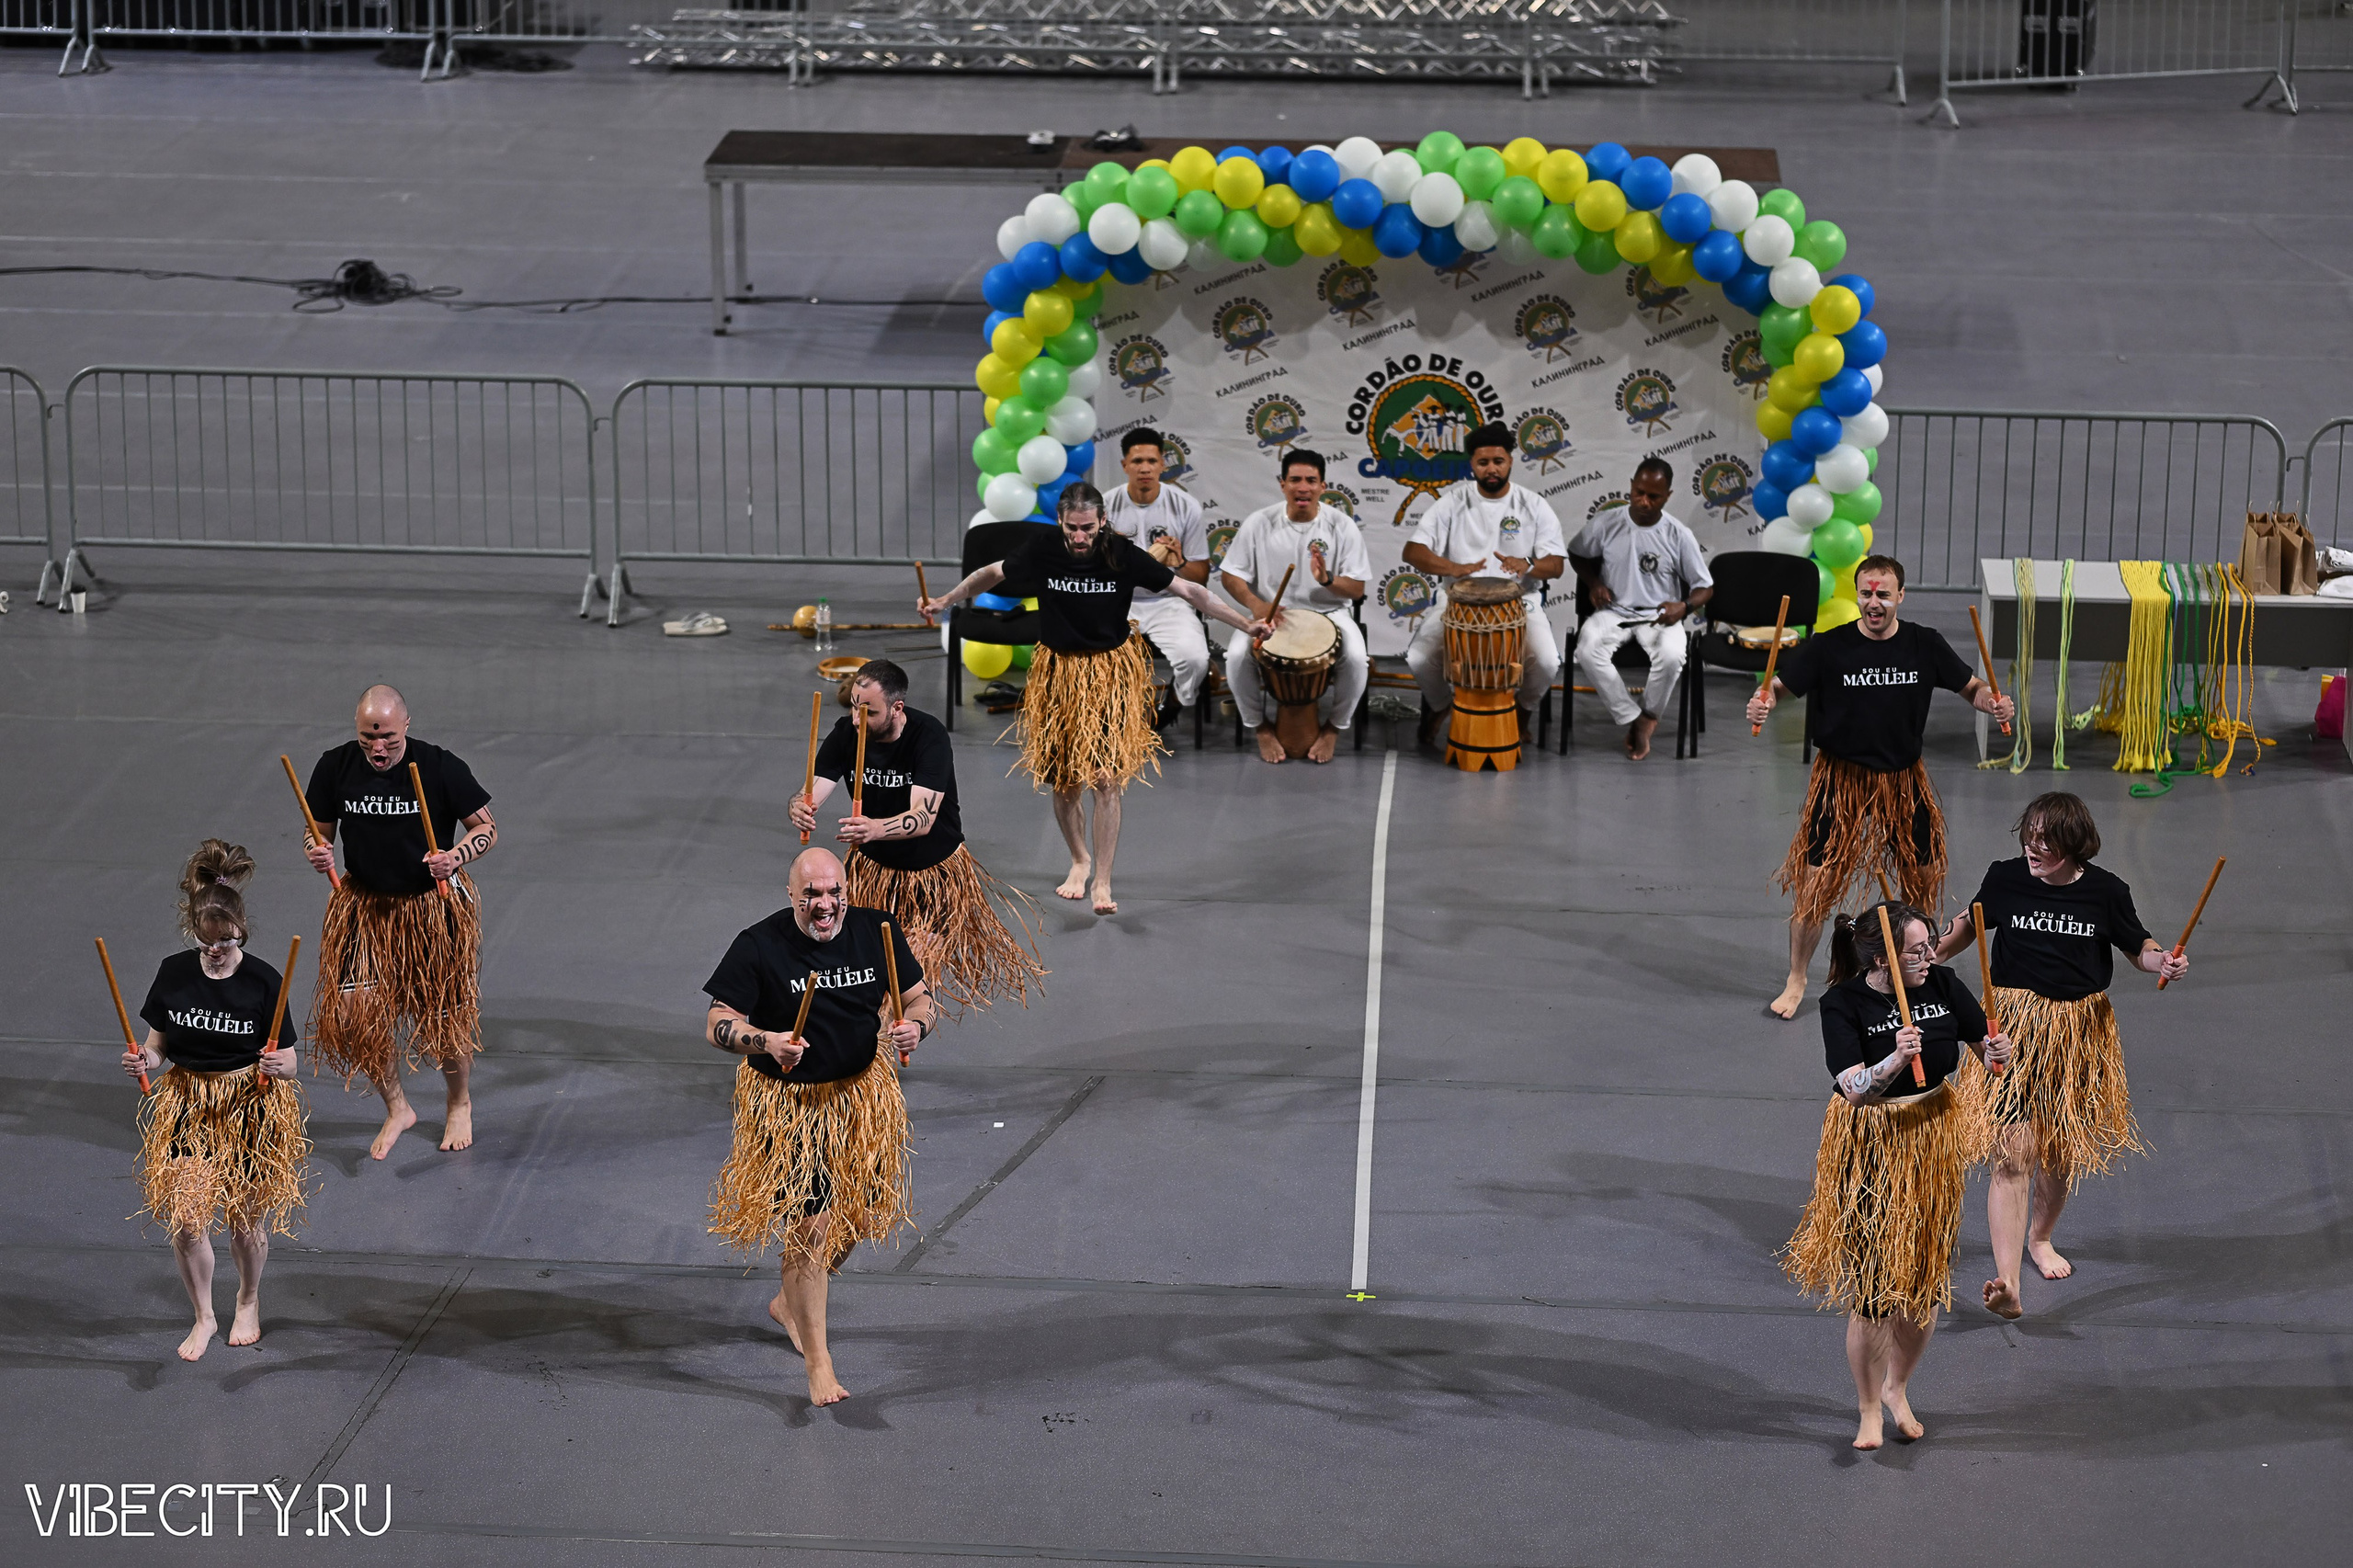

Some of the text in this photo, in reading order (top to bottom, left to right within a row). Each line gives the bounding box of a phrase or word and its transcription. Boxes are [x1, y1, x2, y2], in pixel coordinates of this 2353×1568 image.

[1194, 263, 1267, 295] КАЛИНИНГРАД
[1471, 269, 1545, 303] КАЛИНИНГРАД
[1233, 296, 1247, 305] DE
[1249, 298, 1273, 321] OURO
[1537, 294, 1551, 302] DE
[1552, 295, 1576, 319] OURO
[1342, 318, 1416, 352] КАЛИНИНГРАД
[1644, 313, 1720, 347] КАЛИНИНГРАД
[1745, 329, 1757, 338] DE
[1130, 334, 1142, 343] DE
[1145, 335, 1168, 358] OURO
[1215, 366, 1289, 399] КАЛИНИНГРАД
[1531, 356, 1606, 389] КАЛИНИНГРАД
[1637, 369, 1651, 377] DE
[1653, 369, 1677, 392] OURO
[1267, 393, 1280, 402] DE
[1282, 394, 1306, 416] OURO
[1346, 353, 1506, 435] CORDÃO DE OUR
[1093, 415, 1158, 443] АЛИНИНГРАД
[1530, 407, 1544, 415] DE
[1547, 408, 1570, 431] OURO
[1168, 433, 1191, 455] OURO
[1358, 457, 1475, 481] CAPOEIR
[1714, 453, 1728, 461] DE
[1730, 455, 1754, 478] OURO
[1336, 483, 1359, 506] OURO
[1538, 471, 1604, 499] ЛИНИНГРАД
[1608, 491, 1621, 500] DE
[1217, 518, 1231, 527] DE
[1398, 565, 1412, 574] DE
[1048, 578, 1117, 594] MACULELE
[1843, 671, 1918, 687] MACULELE
[2011, 915, 2096, 937] MACULELE
[2033, 910, 2054, 919] SOU
[168, 1009, 255, 1035] MACULELE
[190, 1007, 211, 1017] SOU
